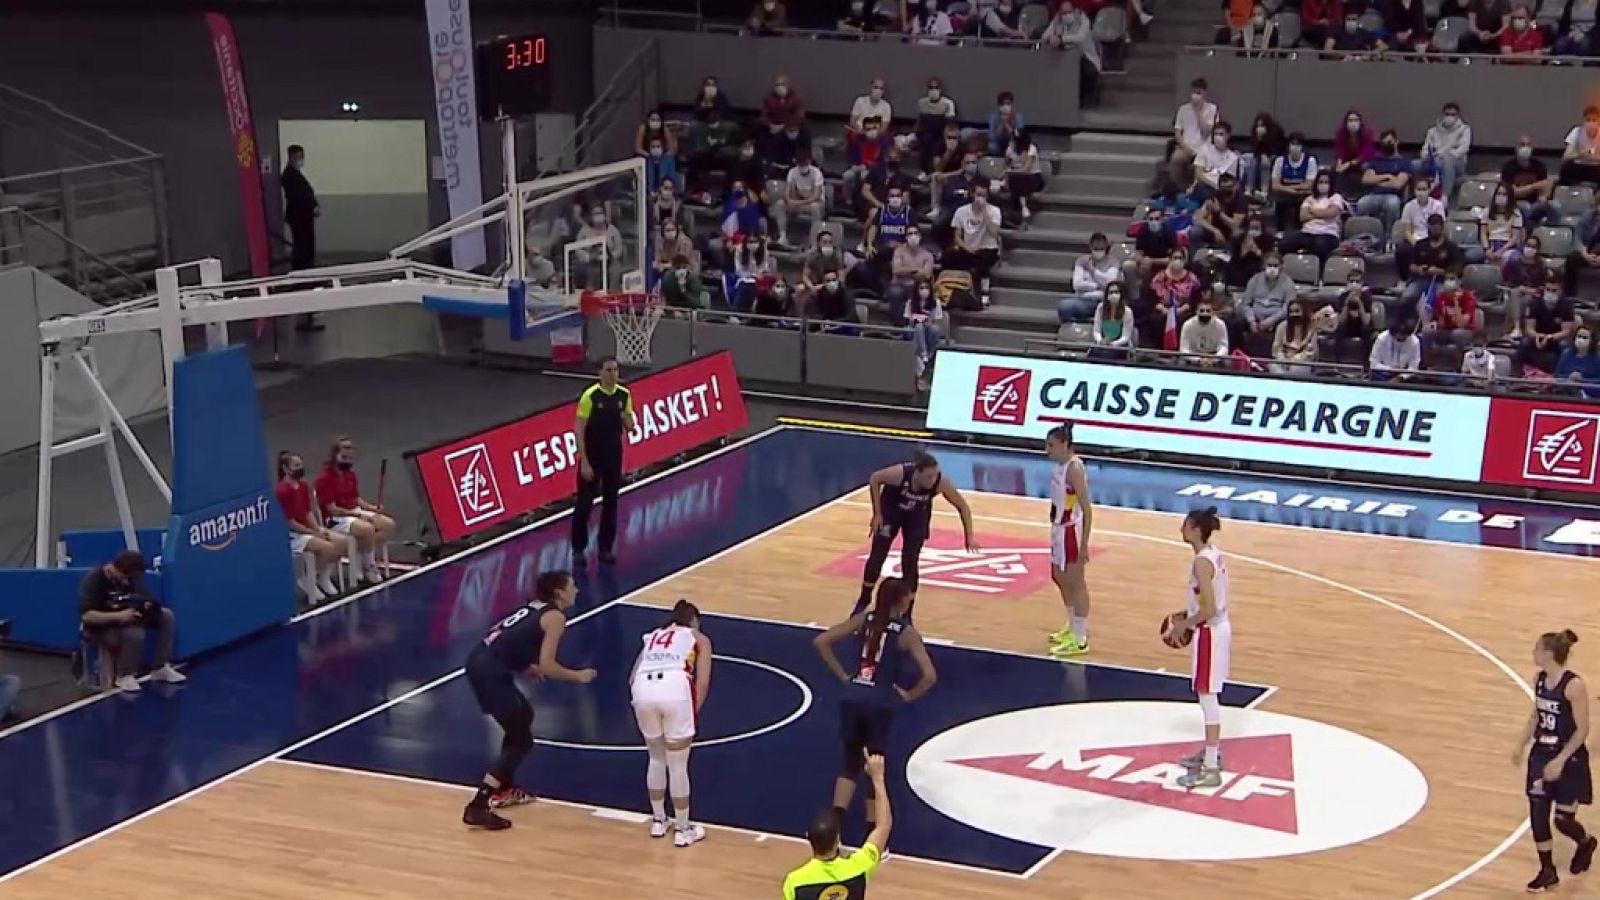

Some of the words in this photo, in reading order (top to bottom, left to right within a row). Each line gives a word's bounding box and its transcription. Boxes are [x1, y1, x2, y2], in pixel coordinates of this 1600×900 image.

[506, 38, 545, 70] 3:30
[1040, 377, 1180, 420] CAISSE
[1189, 391, 1437, 443] D'EPARGNE
[189, 495, 270, 546] amazon.fr
[1175, 483, 1418, 518] MAIRIE
[1436, 508, 1526, 529] DE
[502, 607, 530, 628] 8
[647, 630, 676, 652] 14
[1025, 748, 1296, 801] MAIF
